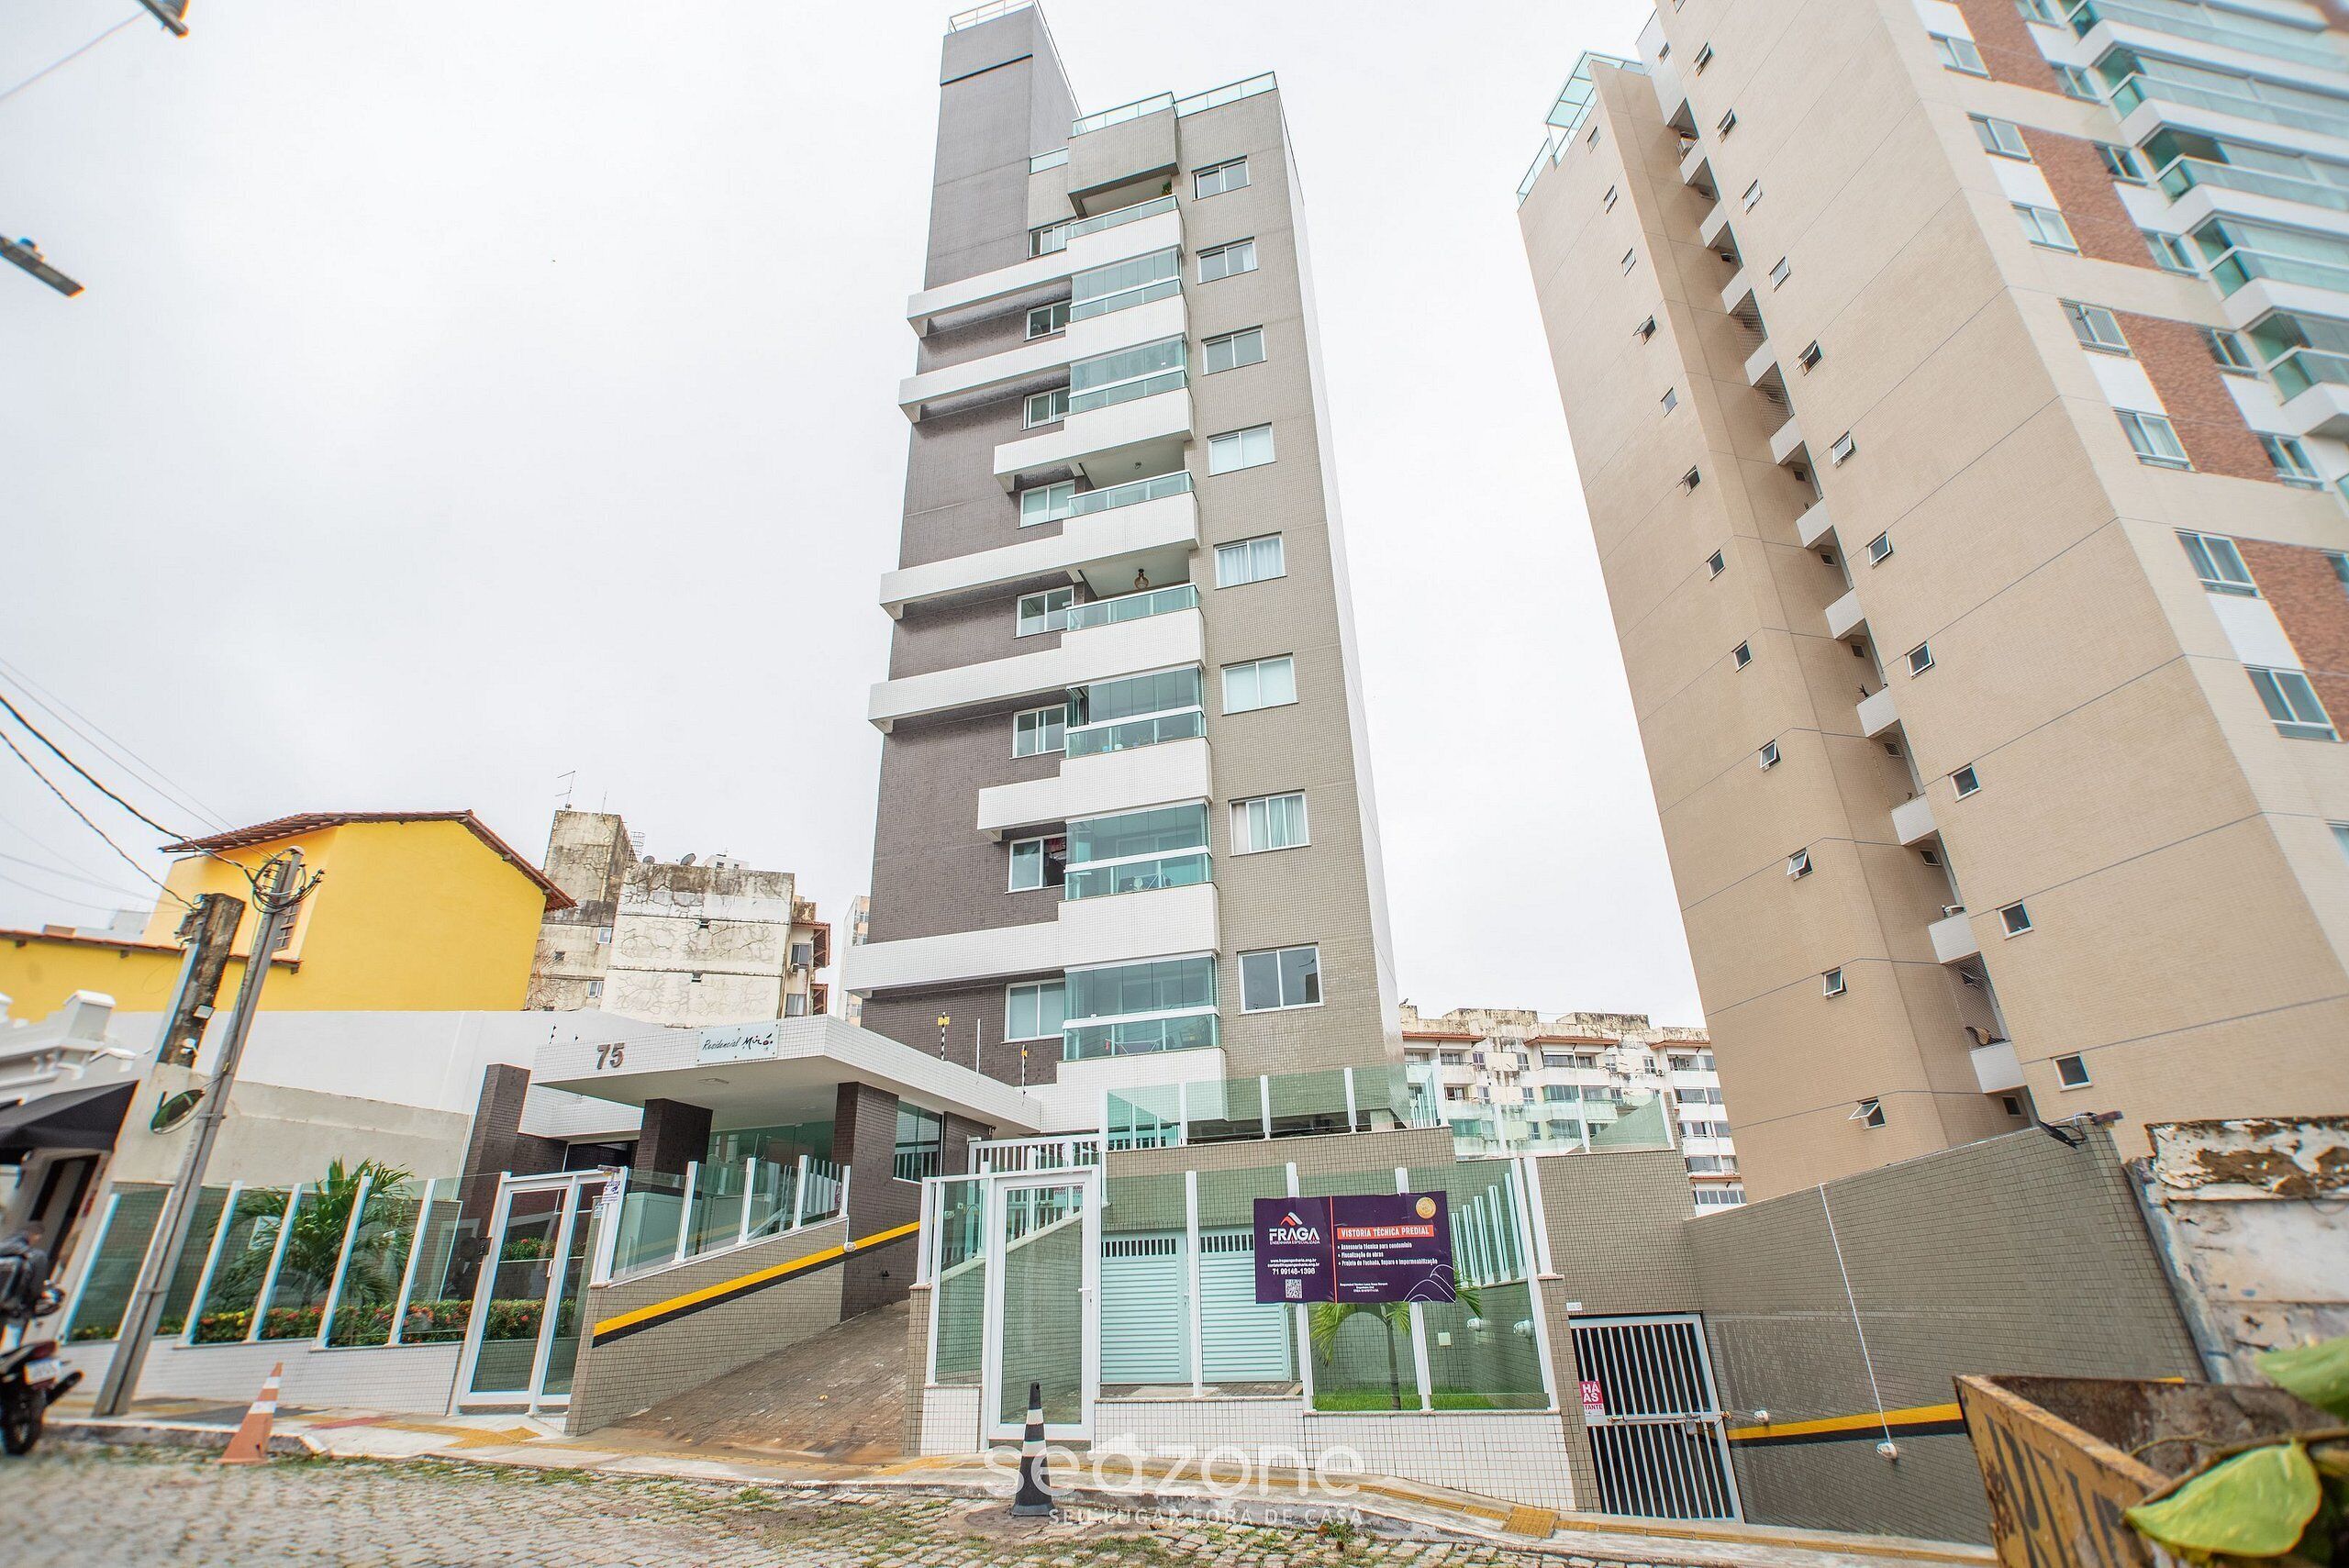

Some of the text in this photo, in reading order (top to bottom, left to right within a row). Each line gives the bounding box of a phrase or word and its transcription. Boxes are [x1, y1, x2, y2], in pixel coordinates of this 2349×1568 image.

[702, 1036, 742, 1051] Residencial
[597, 1042, 625, 1070] 75
[1269, 1227, 1321, 1241] FRAGA
[1341, 1226, 1430, 1238] VISTORIA TÉCNICA PREDIAL
[1582, 1381, 1600, 1393] HÁ
